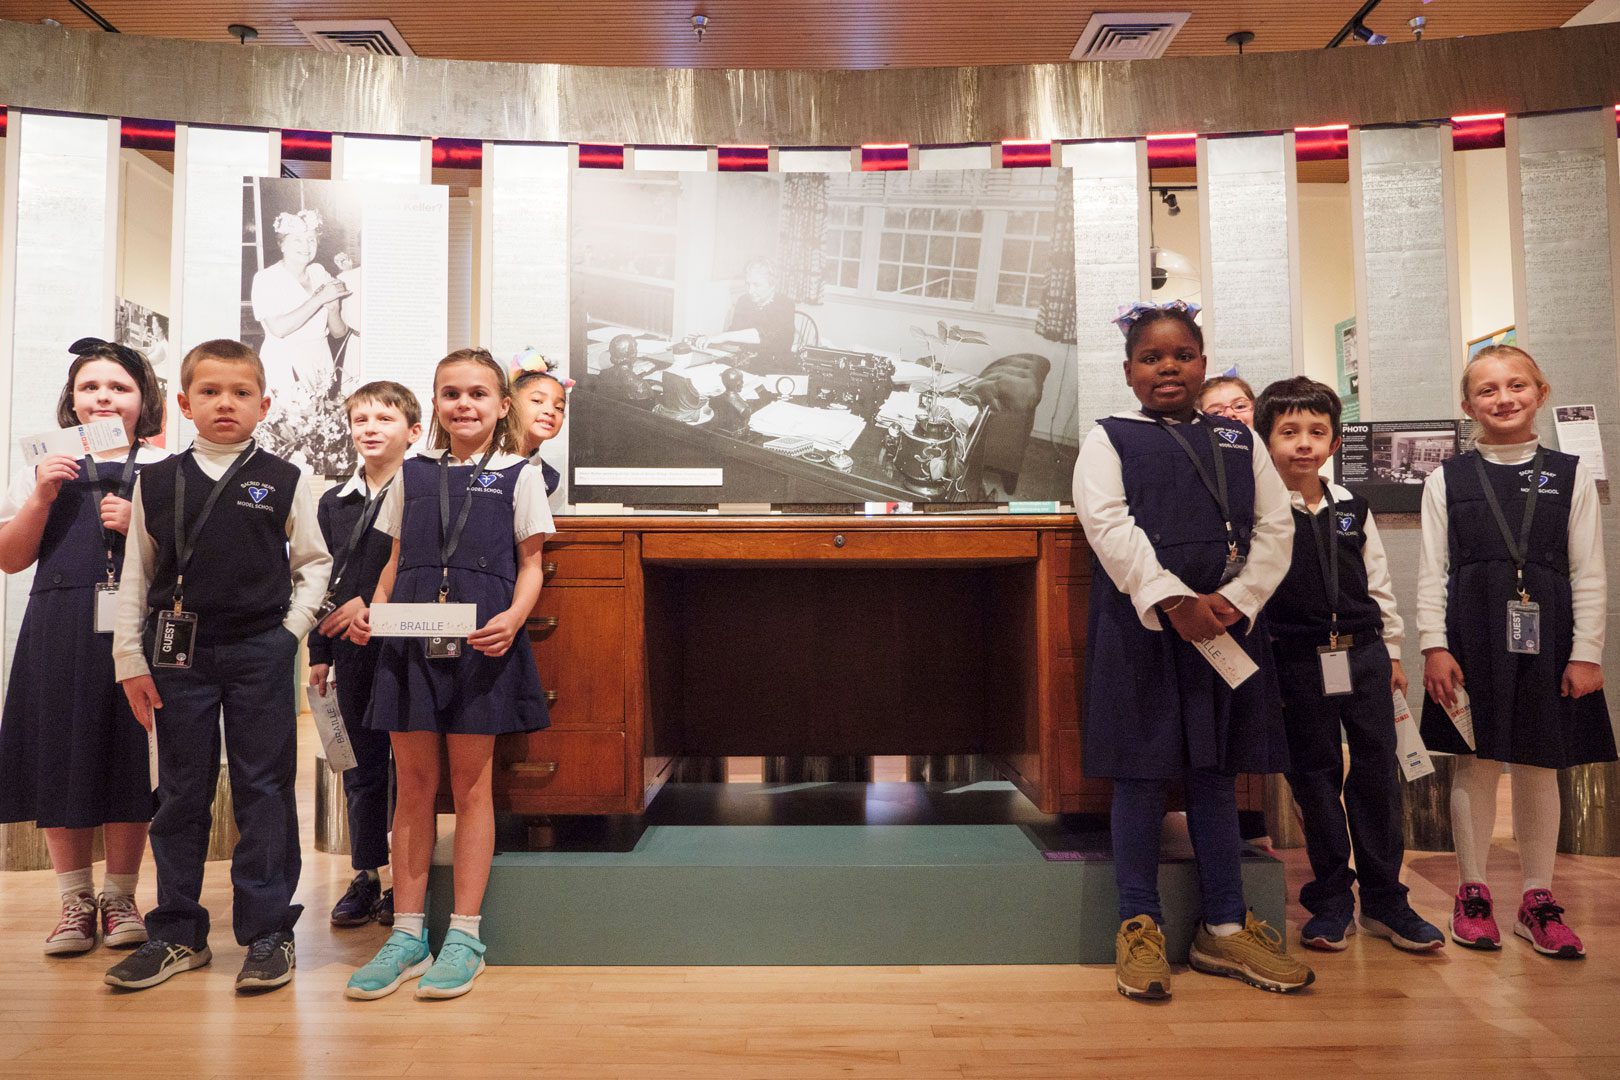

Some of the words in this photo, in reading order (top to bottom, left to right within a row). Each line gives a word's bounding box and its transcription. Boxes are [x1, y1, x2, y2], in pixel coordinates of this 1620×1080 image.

[403, 201, 442, 213] Keller?
[1342, 425, 1369, 433] PHOTO
[240, 480, 260, 488] SACRED
[260, 482, 276, 492] HEART
[484, 486, 504, 494] SCHOOL
[236, 500, 254, 508] MODEL
[254, 503, 274, 512] SCHOOL
[399, 621, 445, 631] BRAILLE
[1512, 611, 1522, 640] GUEST
[162, 621, 176, 653] GUEST
[326, 706, 345, 744] BRAILLE
